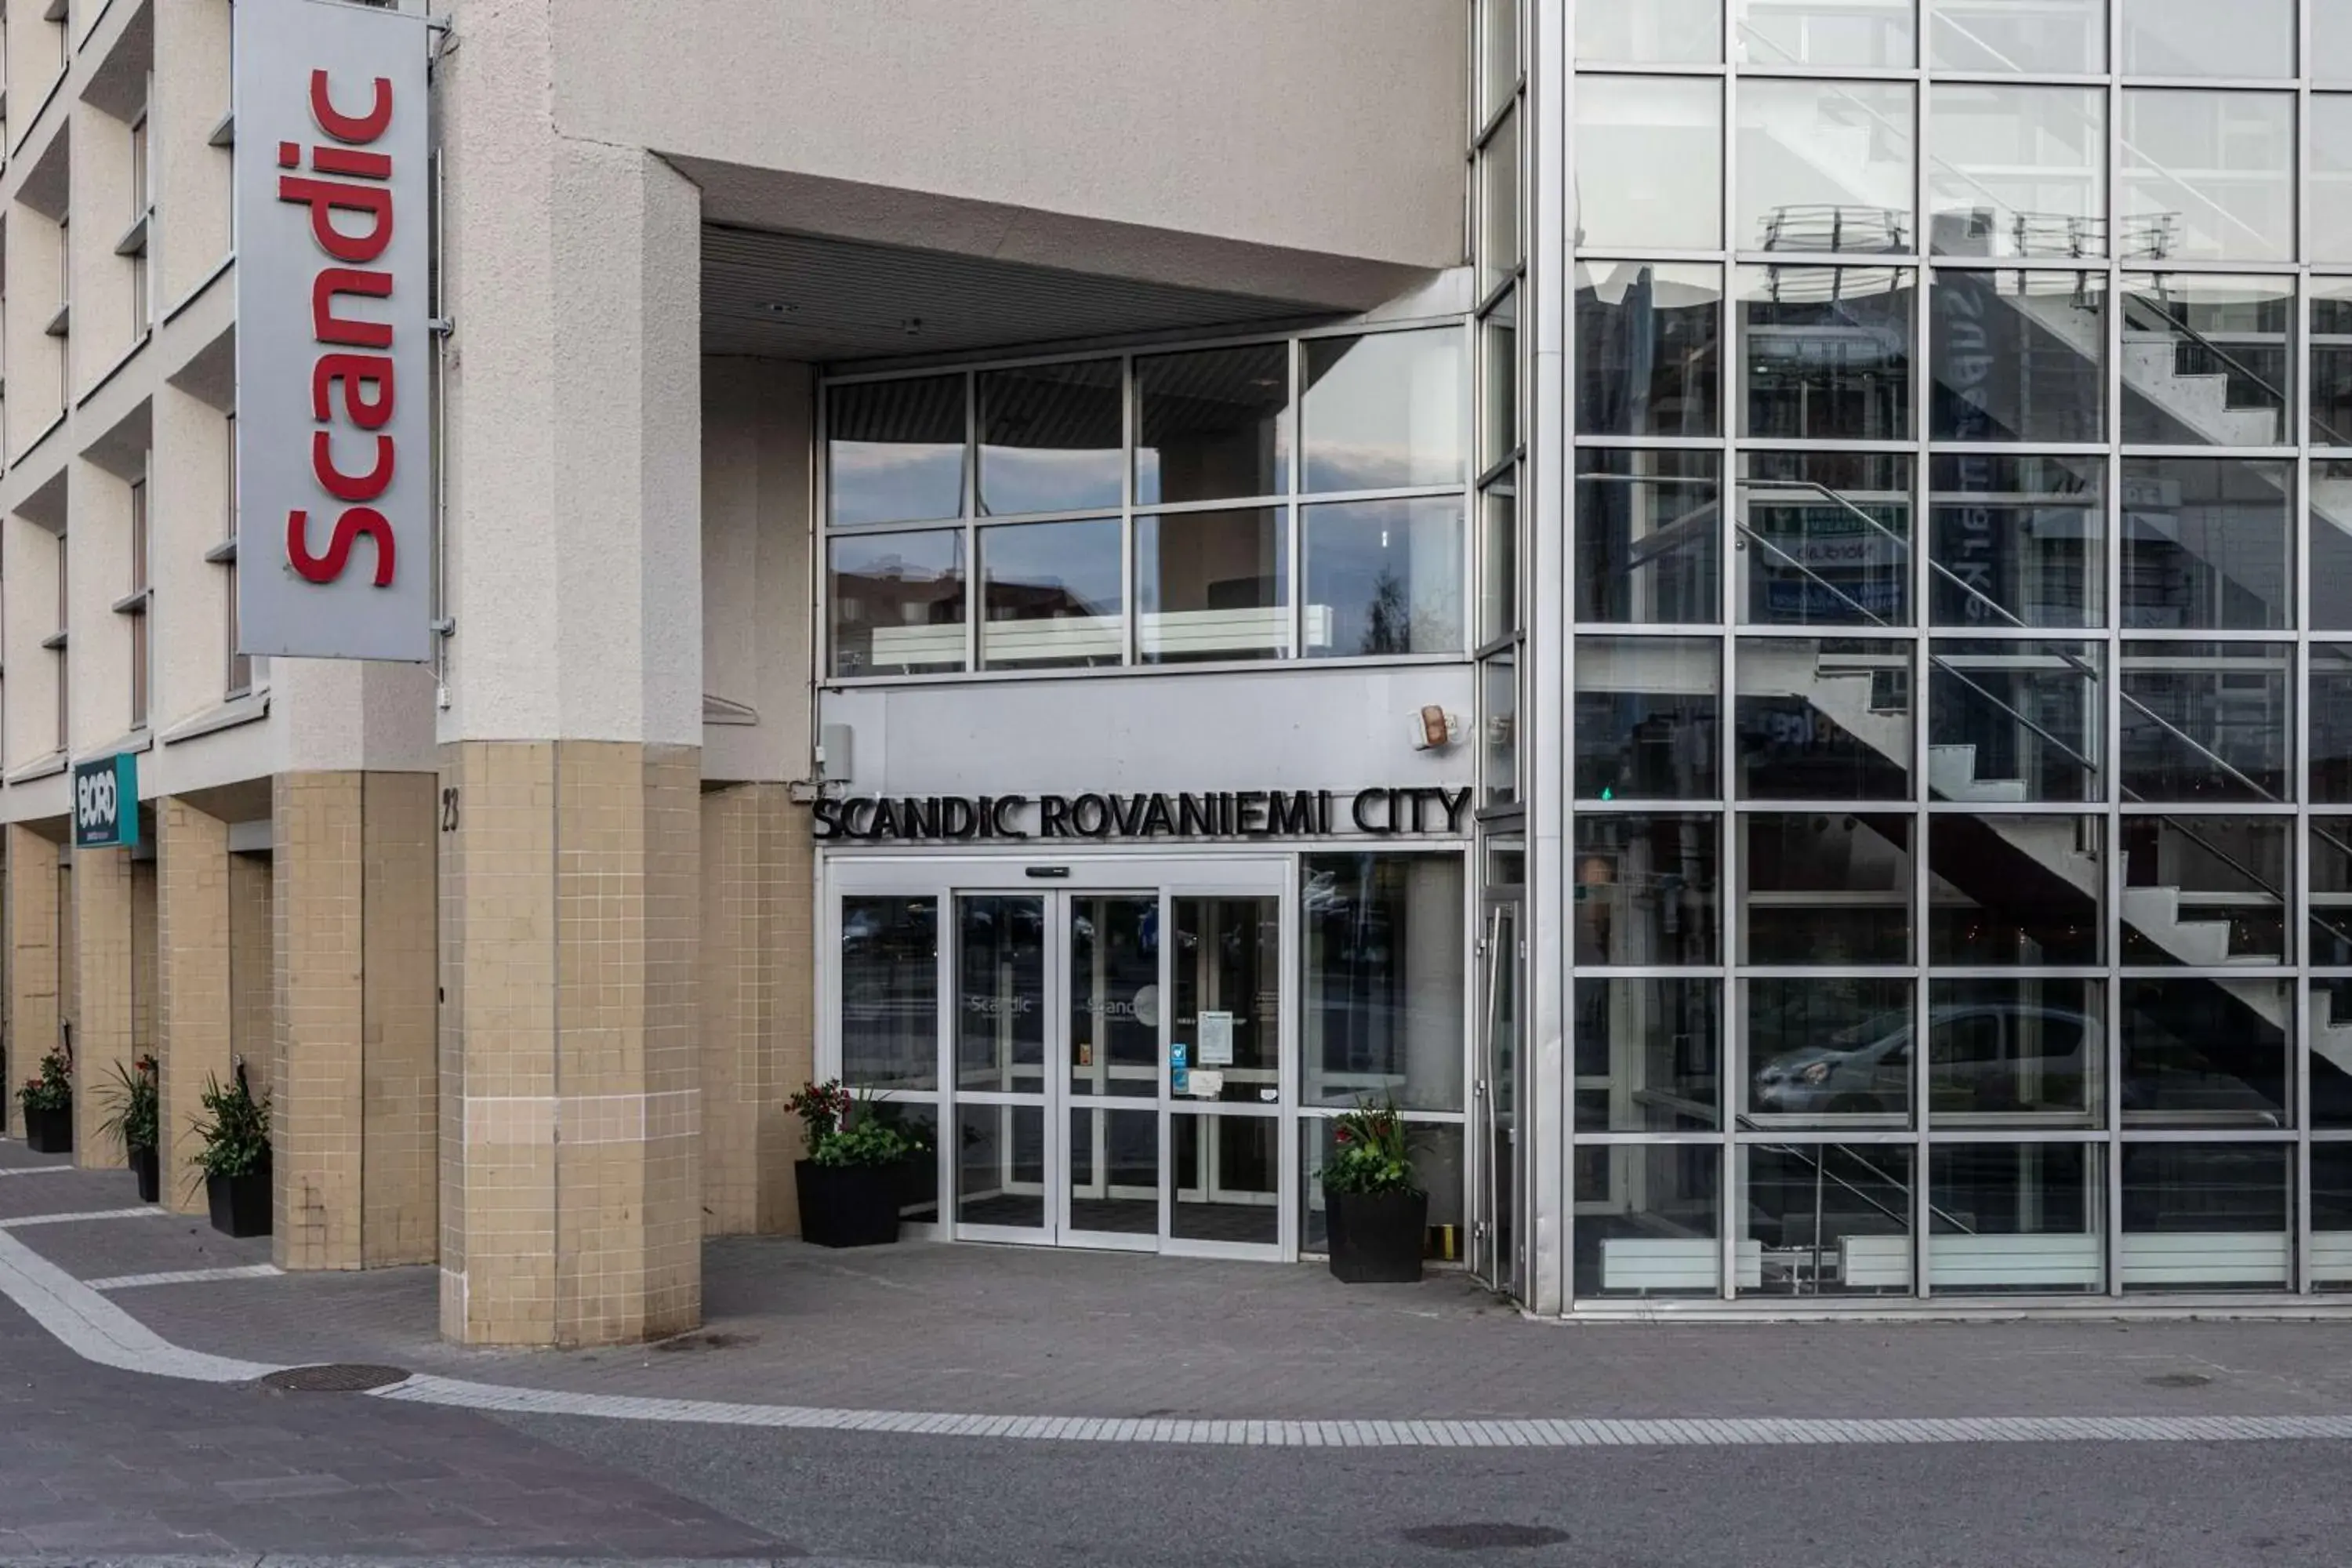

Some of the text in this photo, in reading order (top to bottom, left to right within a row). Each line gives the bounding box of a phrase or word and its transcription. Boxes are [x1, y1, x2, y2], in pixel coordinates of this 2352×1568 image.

[278, 68, 396, 588] Scandic
[812, 786, 1474, 839] SCANDIC ROVANIEMI CITY
